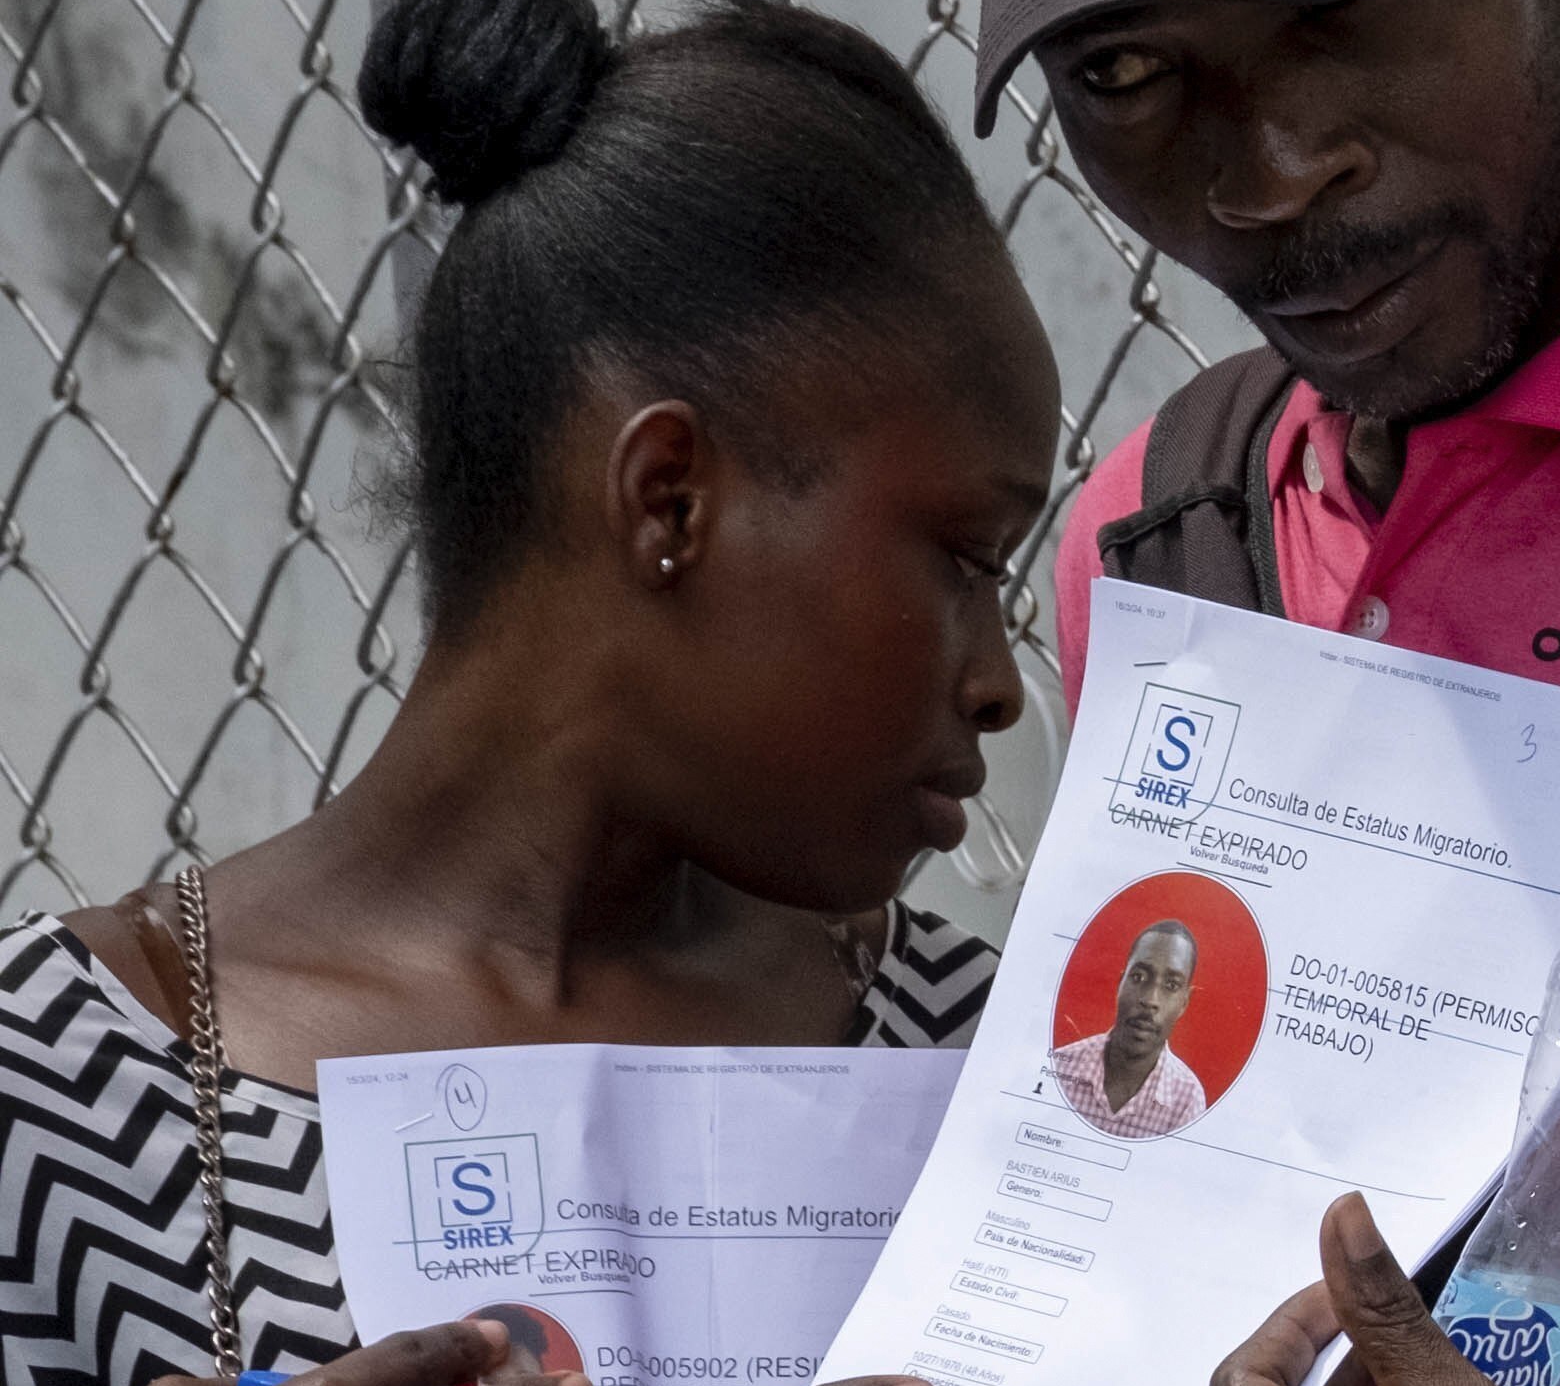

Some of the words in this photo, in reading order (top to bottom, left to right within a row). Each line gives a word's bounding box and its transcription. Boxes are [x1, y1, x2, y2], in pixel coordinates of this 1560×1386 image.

[1156, 715, 1196, 772] S
[1516, 723, 1537, 764] 3
[1134, 776, 1192, 809] SIREX
[1110, 803, 1198, 843] CARNET
[1199, 825, 1308, 871] EXPIRADO
[1229, 776, 1309, 817] Consulta
[1314, 800, 1338, 825] de
[1342, 806, 1409, 842] Estatus
[1413, 822, 1512, 871] Migratorio.
[1190, 845, 1219, 861] Volver
[1220, 853, 1269, 875] Busqueda
[1290, 954, 1429, 1008] DO-01-005815
[1282, 984, 1391, 1033] TEMPORAL
[1398, 1016, 1433, 1042] DE
[1275, 1012, 1375, 1063] TRABAJO)
[1024, 1128, 1065, 1149] Nombre:
[451, 1162, 497, 1215] S
[1006, 1160, 1051, 1180] BASTIEN
[1050, 1173, 1081, 1188] ARIUS
[557, 1198, 640, 1226] Consulta
[649, 1205, 678, 1226] de
[688, 1205, 777, 1228] Estatus
[985, 1210, 1031, 1230] Masculino
[442, 1224, 515, 1250] SIREX
[423, 1253, 536, 1281] CARNET
[545, 1249, 656, 1279] EXPIRADO
[746, 1356, 826, 1383] (RESI
